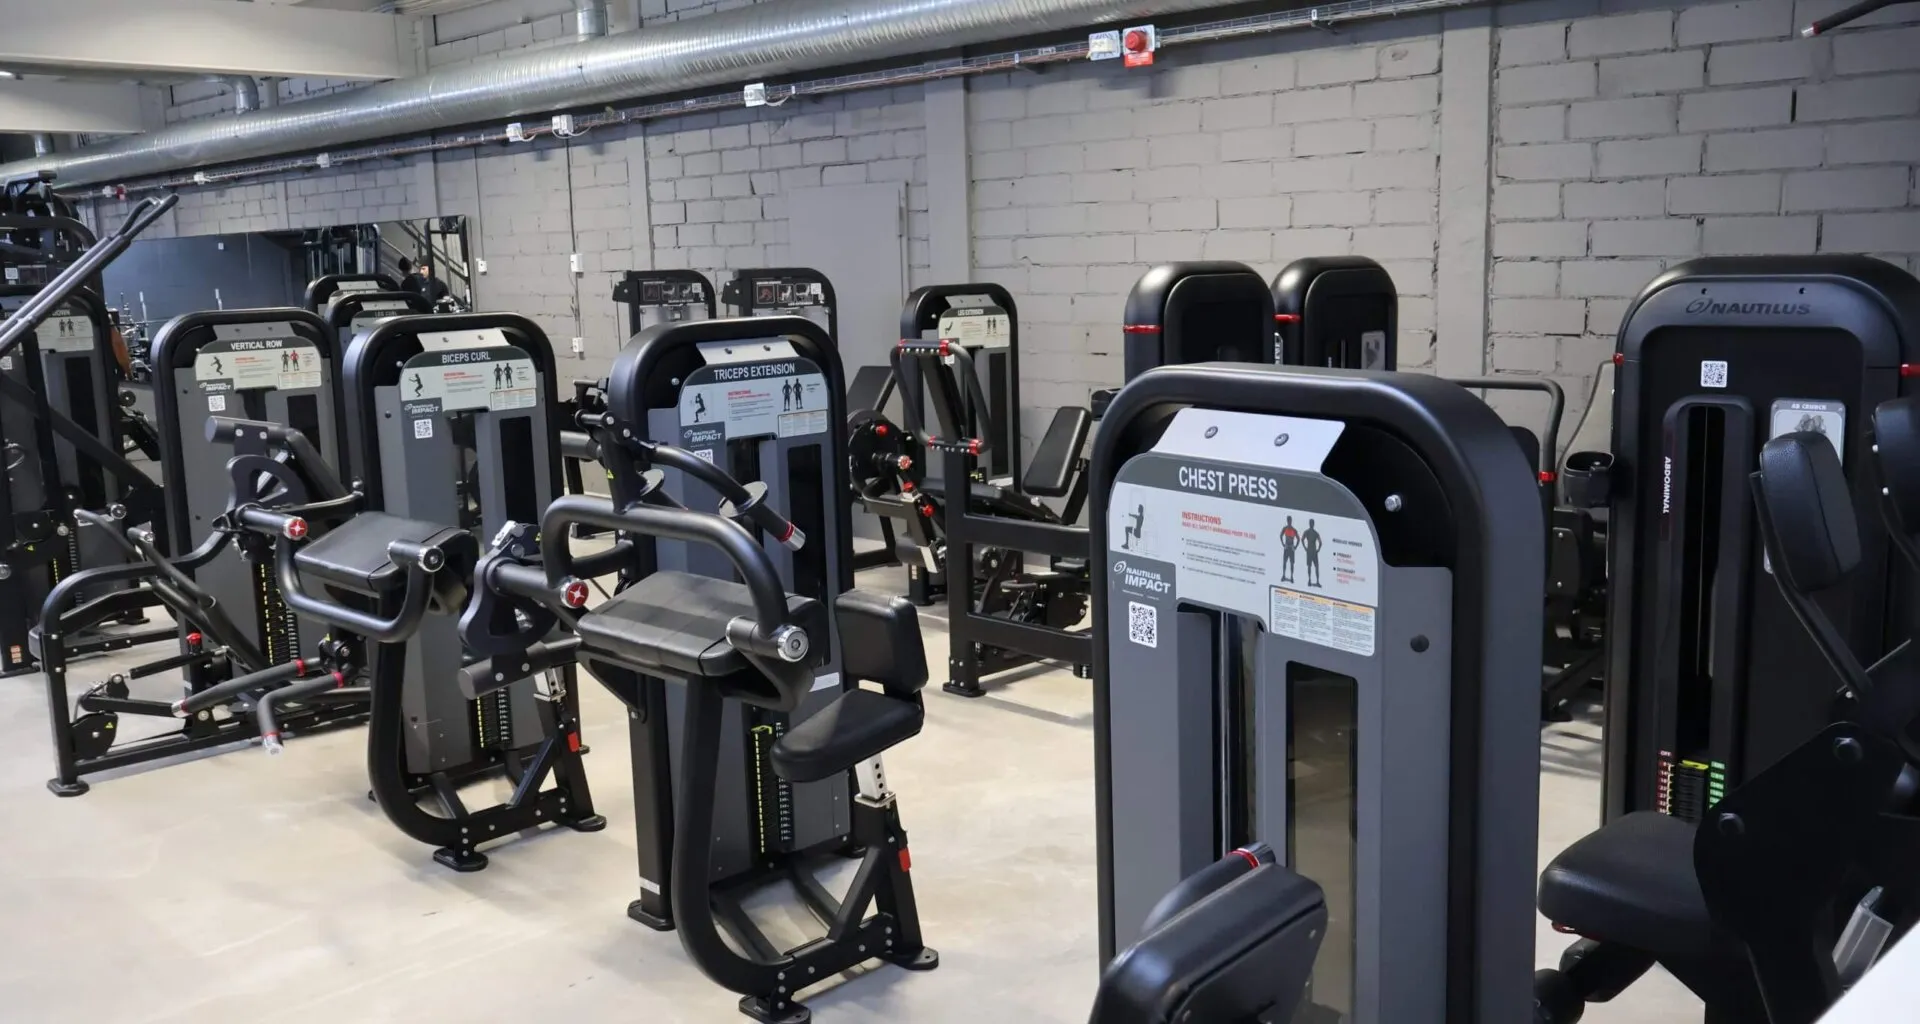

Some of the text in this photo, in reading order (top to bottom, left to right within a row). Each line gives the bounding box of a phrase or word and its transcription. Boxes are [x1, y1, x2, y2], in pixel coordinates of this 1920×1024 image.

[1710, 303, 1811, 315] NAUTILUS
[231, 340, 283, 351] VERTICAL ROW
[442, 351, 491, 364] BICEPS CURL
[714, 362, 795, 381] TRICEPS EXTENSION
[411, 406, 439, 415] IMPACT
[691, 433, 722, 443] IMPACT
[1178, 466, 1278, 501] CHEST PRESS
[1662, 456, 1672, 514] ABDOMINAL
[1181, 511, 1222, 525] INSTRUCTIONS
[1126, 567, 1161, 580] NAUTILUS
[1124, 574, 1171, 594] IMPACT
